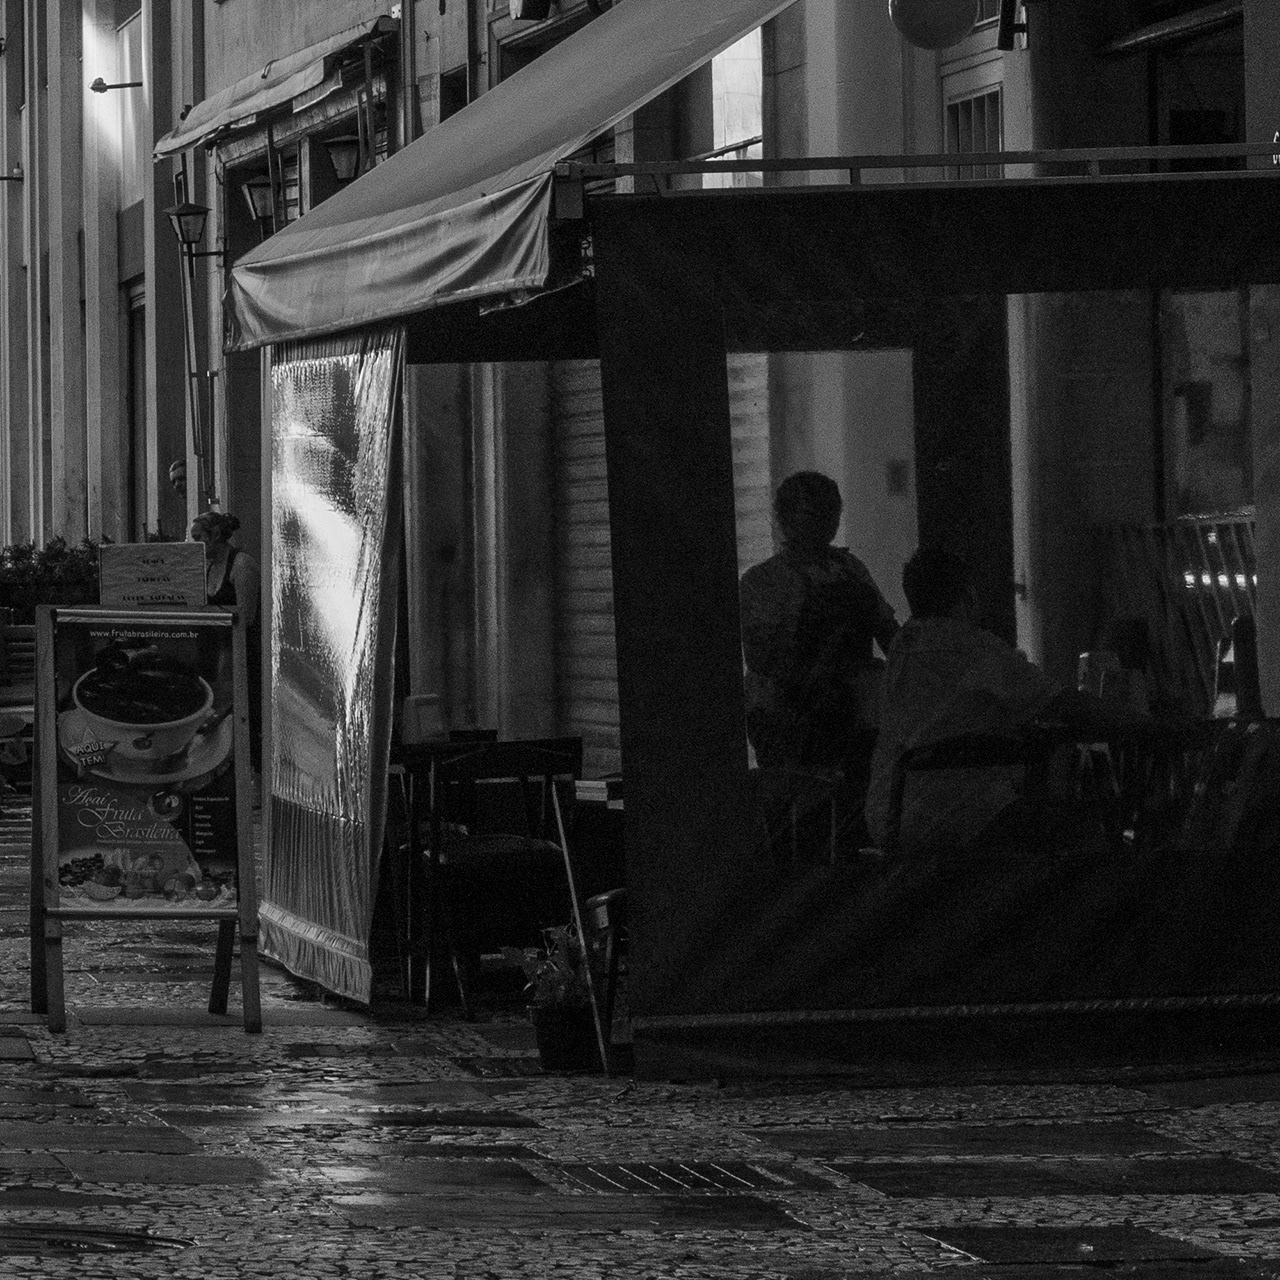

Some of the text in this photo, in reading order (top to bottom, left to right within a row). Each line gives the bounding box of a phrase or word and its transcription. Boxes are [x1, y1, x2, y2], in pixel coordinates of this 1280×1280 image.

[89, 629, 200, 639] www.frutabrasileira.com.br
[75, 741, 106, 756] AQUI
[79, 754, 107, 767] TEM!
[62, 785, 111, 807] Açaí
[76, 799, 145, 828] Fruta
[96, 822, 183, 839] Brasileira
